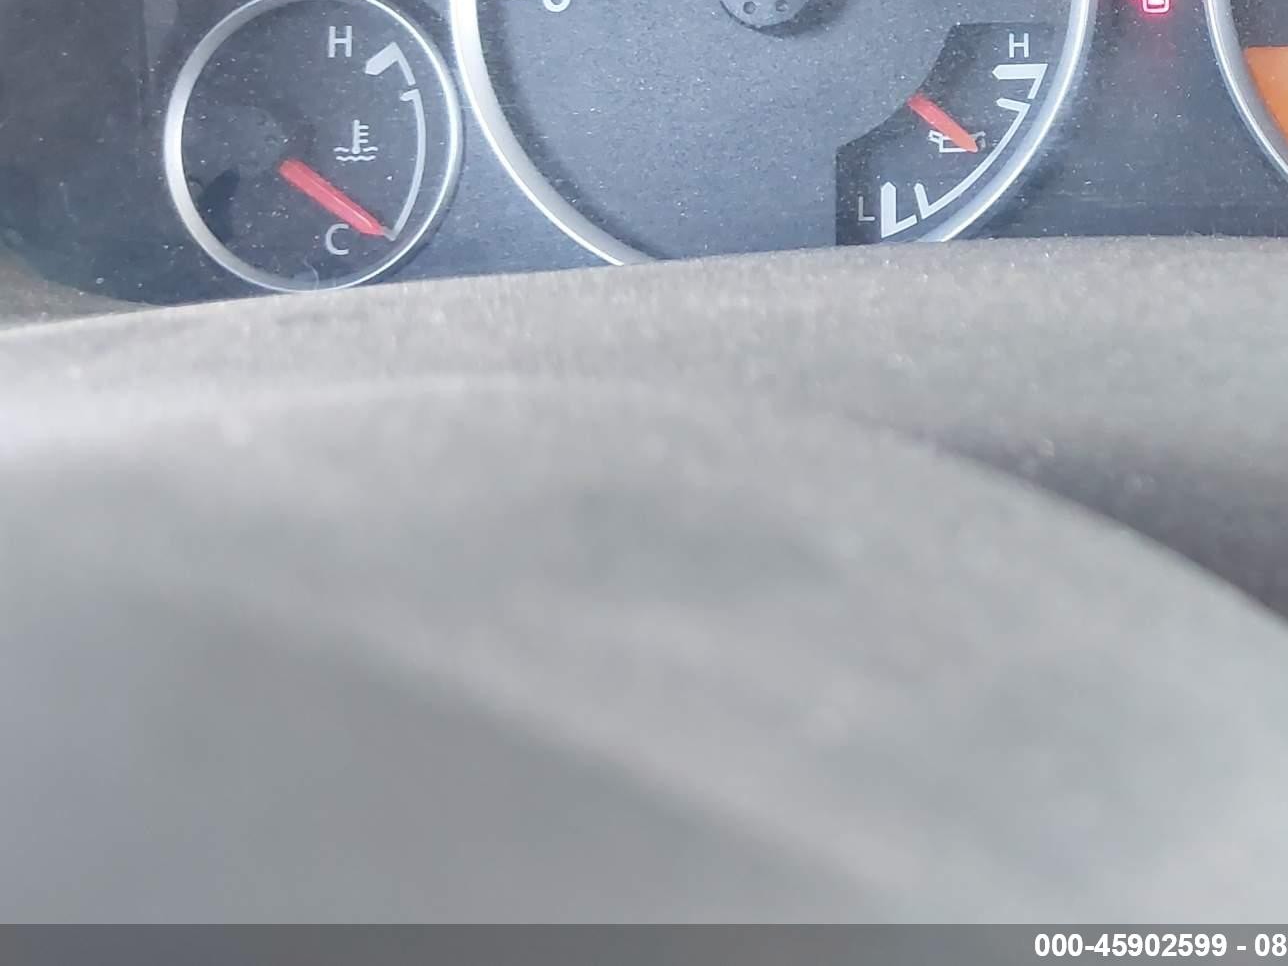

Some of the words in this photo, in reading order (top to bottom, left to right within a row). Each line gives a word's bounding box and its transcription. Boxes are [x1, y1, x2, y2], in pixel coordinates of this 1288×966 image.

[328, 26, 352, 58] H
[1009, 34, 1028, 58] H
[857, 197, 875, 222] L
[325, 223, 350, 255] C
